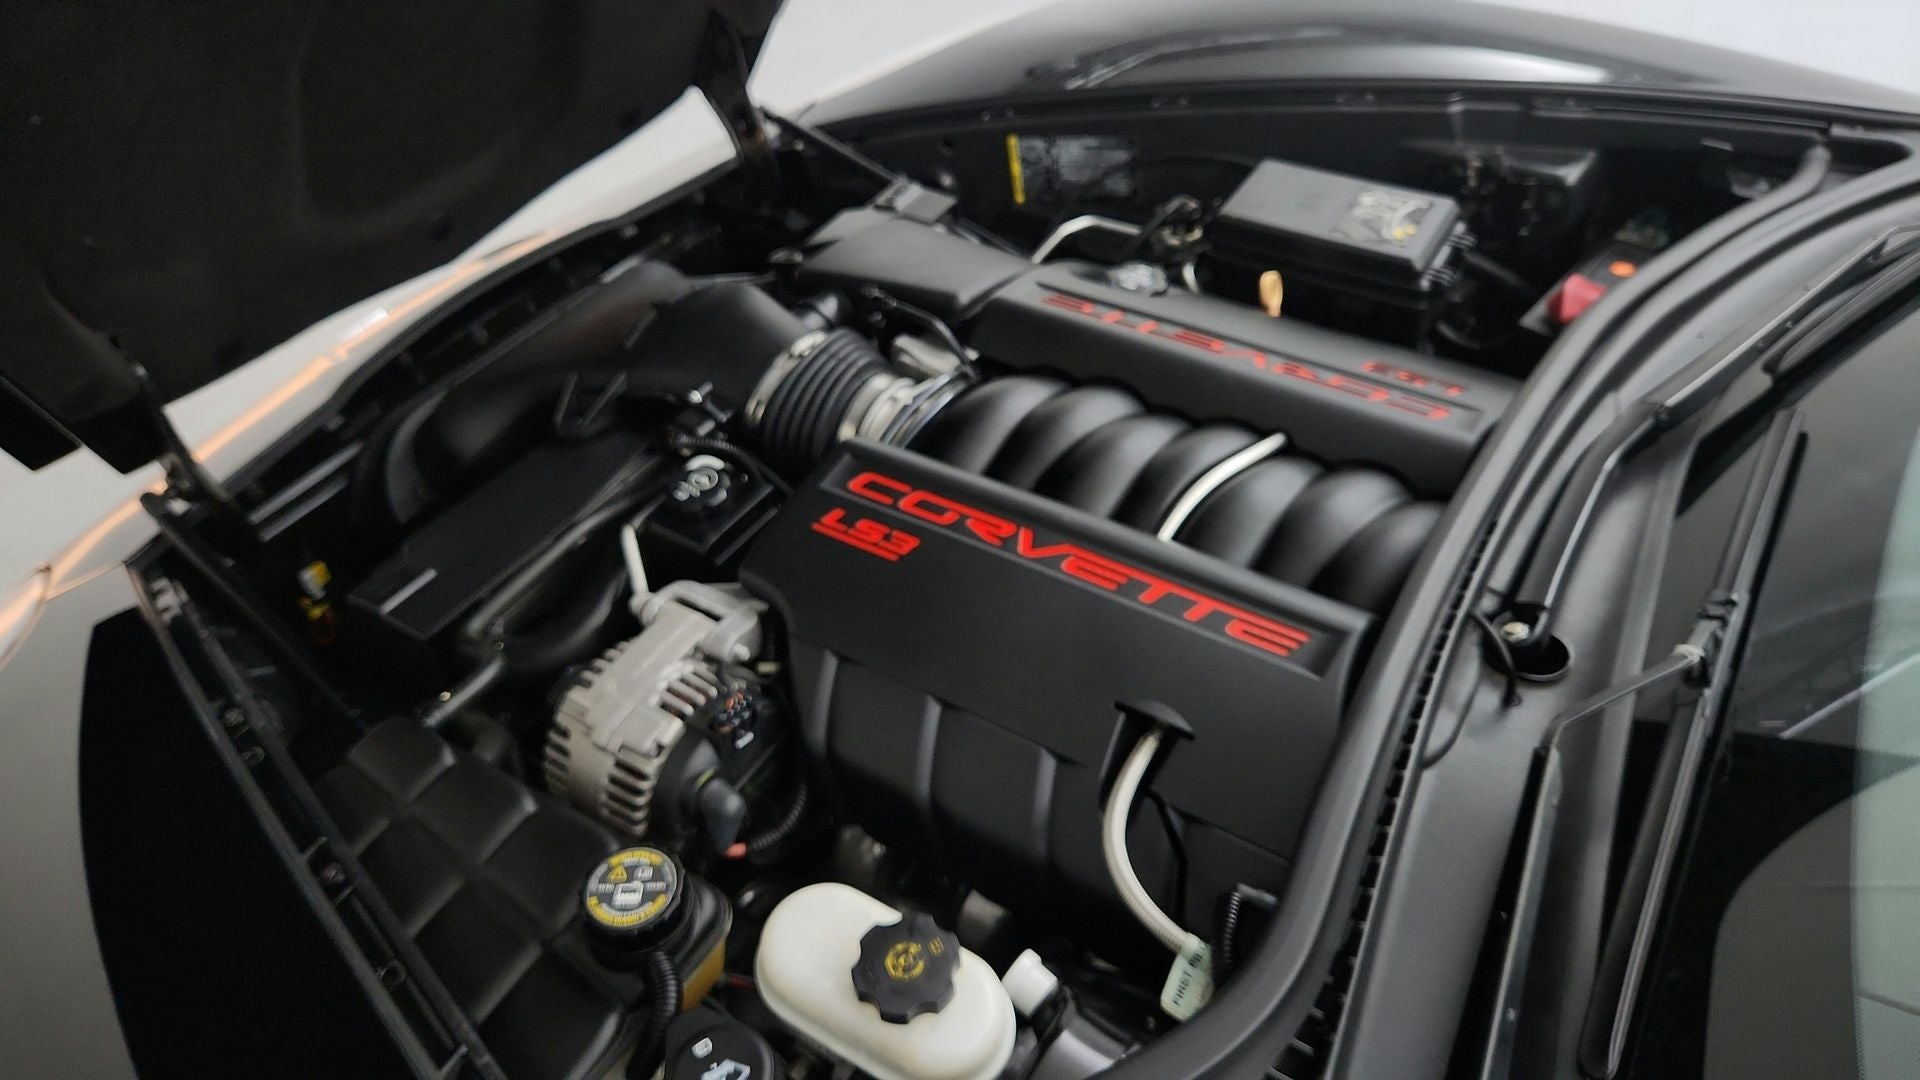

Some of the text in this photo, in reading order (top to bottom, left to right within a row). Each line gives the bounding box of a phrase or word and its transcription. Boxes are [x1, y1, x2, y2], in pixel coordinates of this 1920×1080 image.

[1041, 293, 1451, 421] CORVETTE
[812, 507, 921, 562] LS3
[847, 471, 1309, 657] CORVETTE
